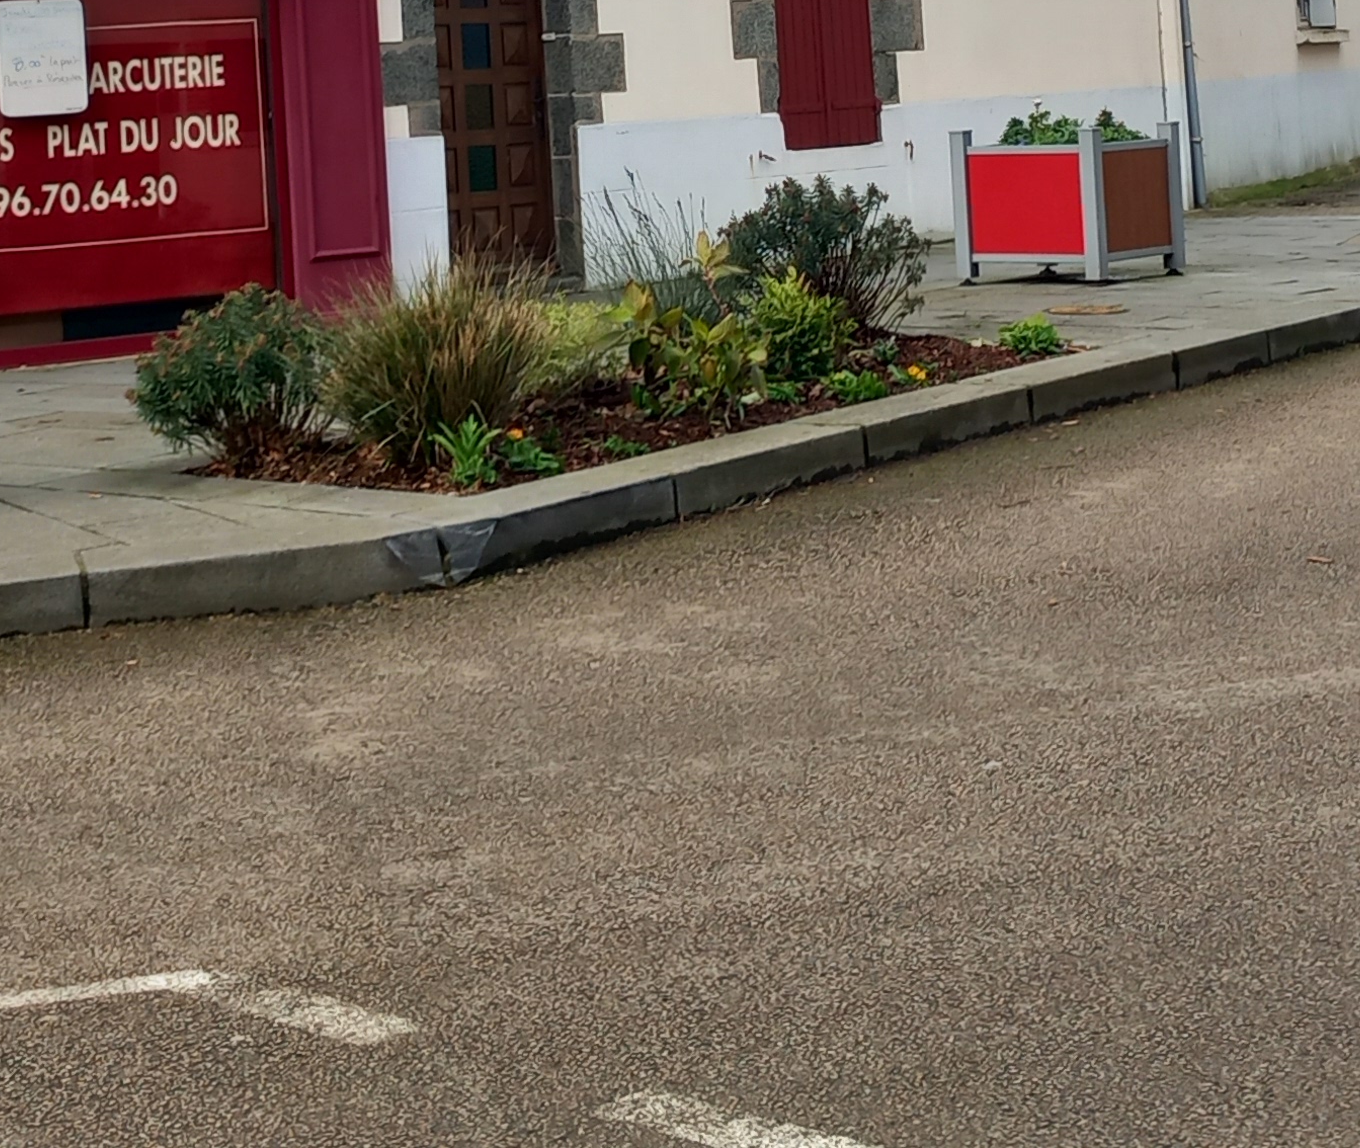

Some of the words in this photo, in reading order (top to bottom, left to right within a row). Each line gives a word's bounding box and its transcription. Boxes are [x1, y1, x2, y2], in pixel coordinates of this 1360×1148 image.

[89, 54, 225, 95] ARCUTERIE
[47, 121, 109, 158] PLAT
[120, 118, 159, 152] DU
[170, 113, 241, 150] JOUR
